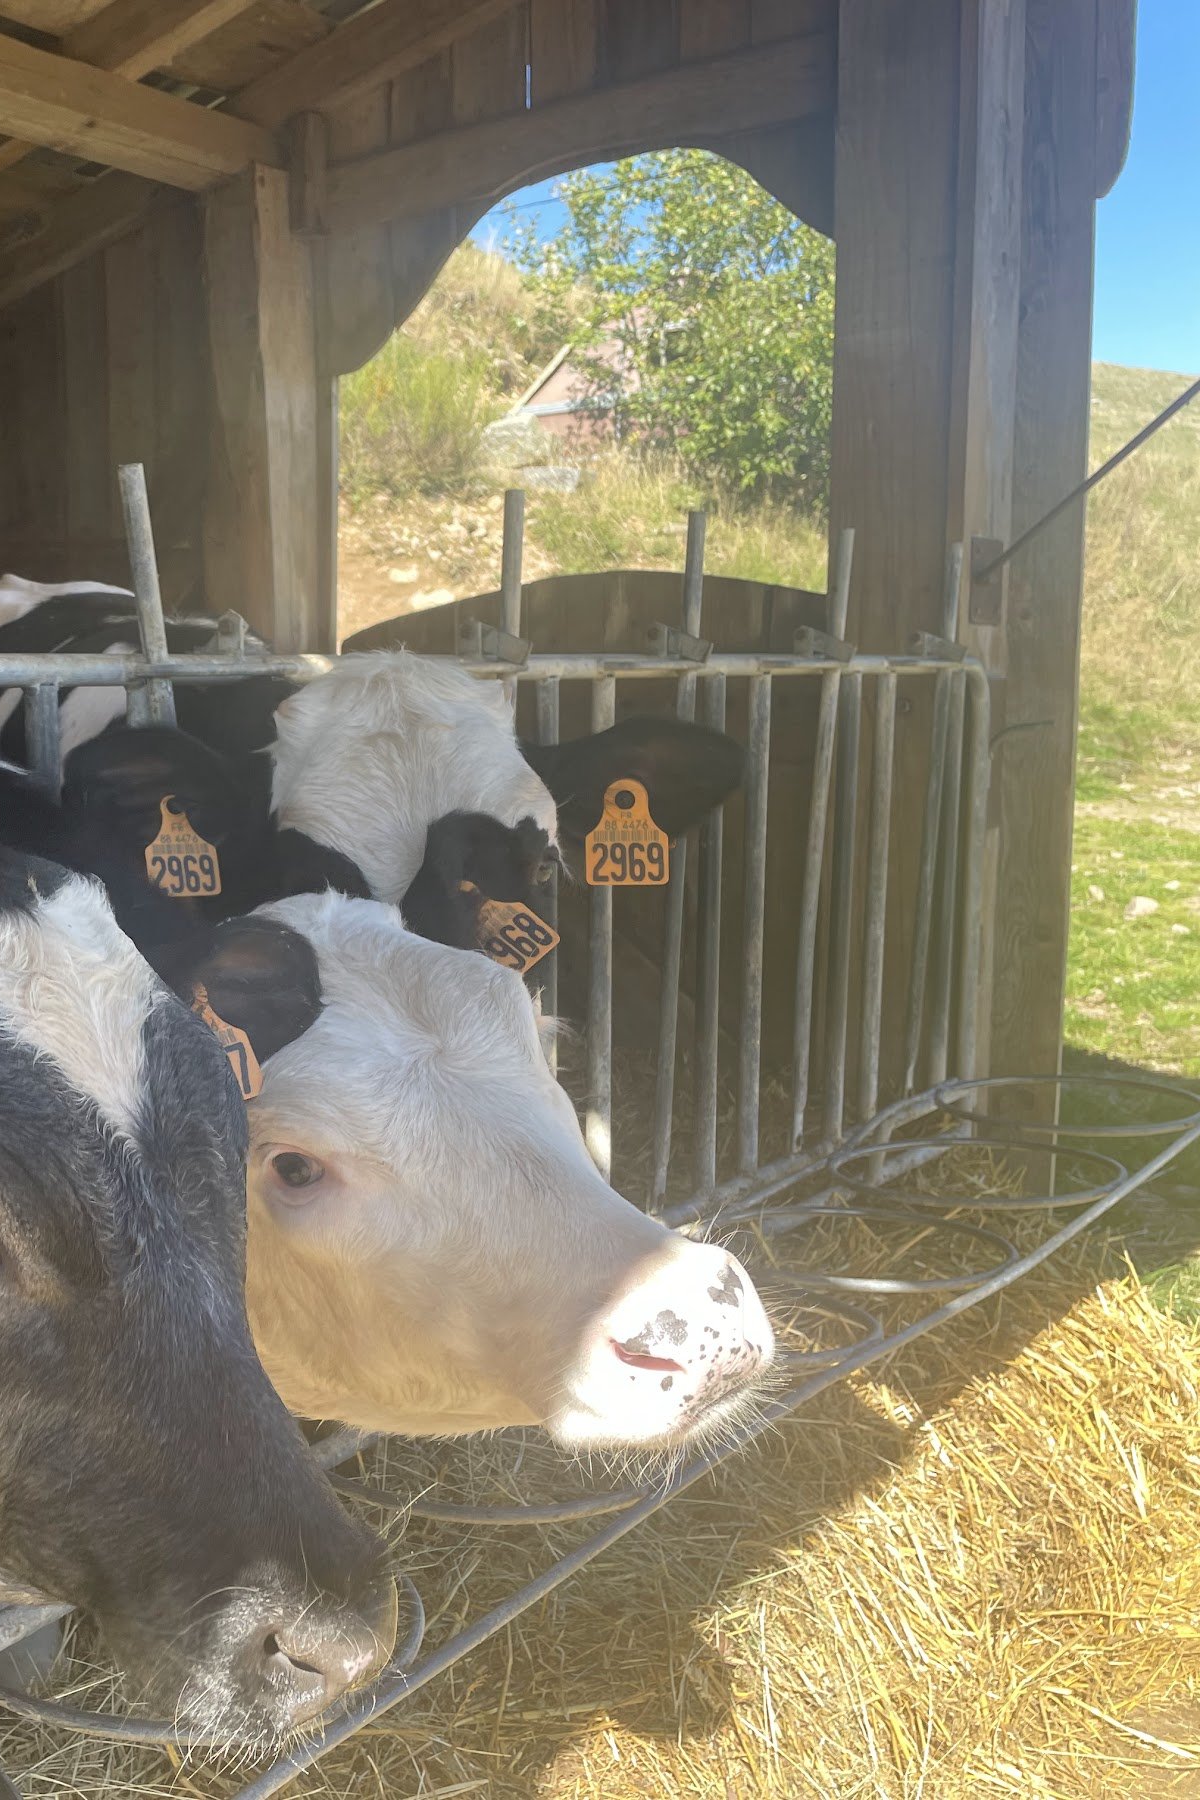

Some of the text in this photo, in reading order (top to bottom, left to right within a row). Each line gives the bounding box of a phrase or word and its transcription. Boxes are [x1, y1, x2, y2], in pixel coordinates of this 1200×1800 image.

[604, 819, 649, 830] 88 4476
[151, 854, 216, 893] 2969
[592, 842, 665, 882] 2969
[484, 912, 554, 970] 968
